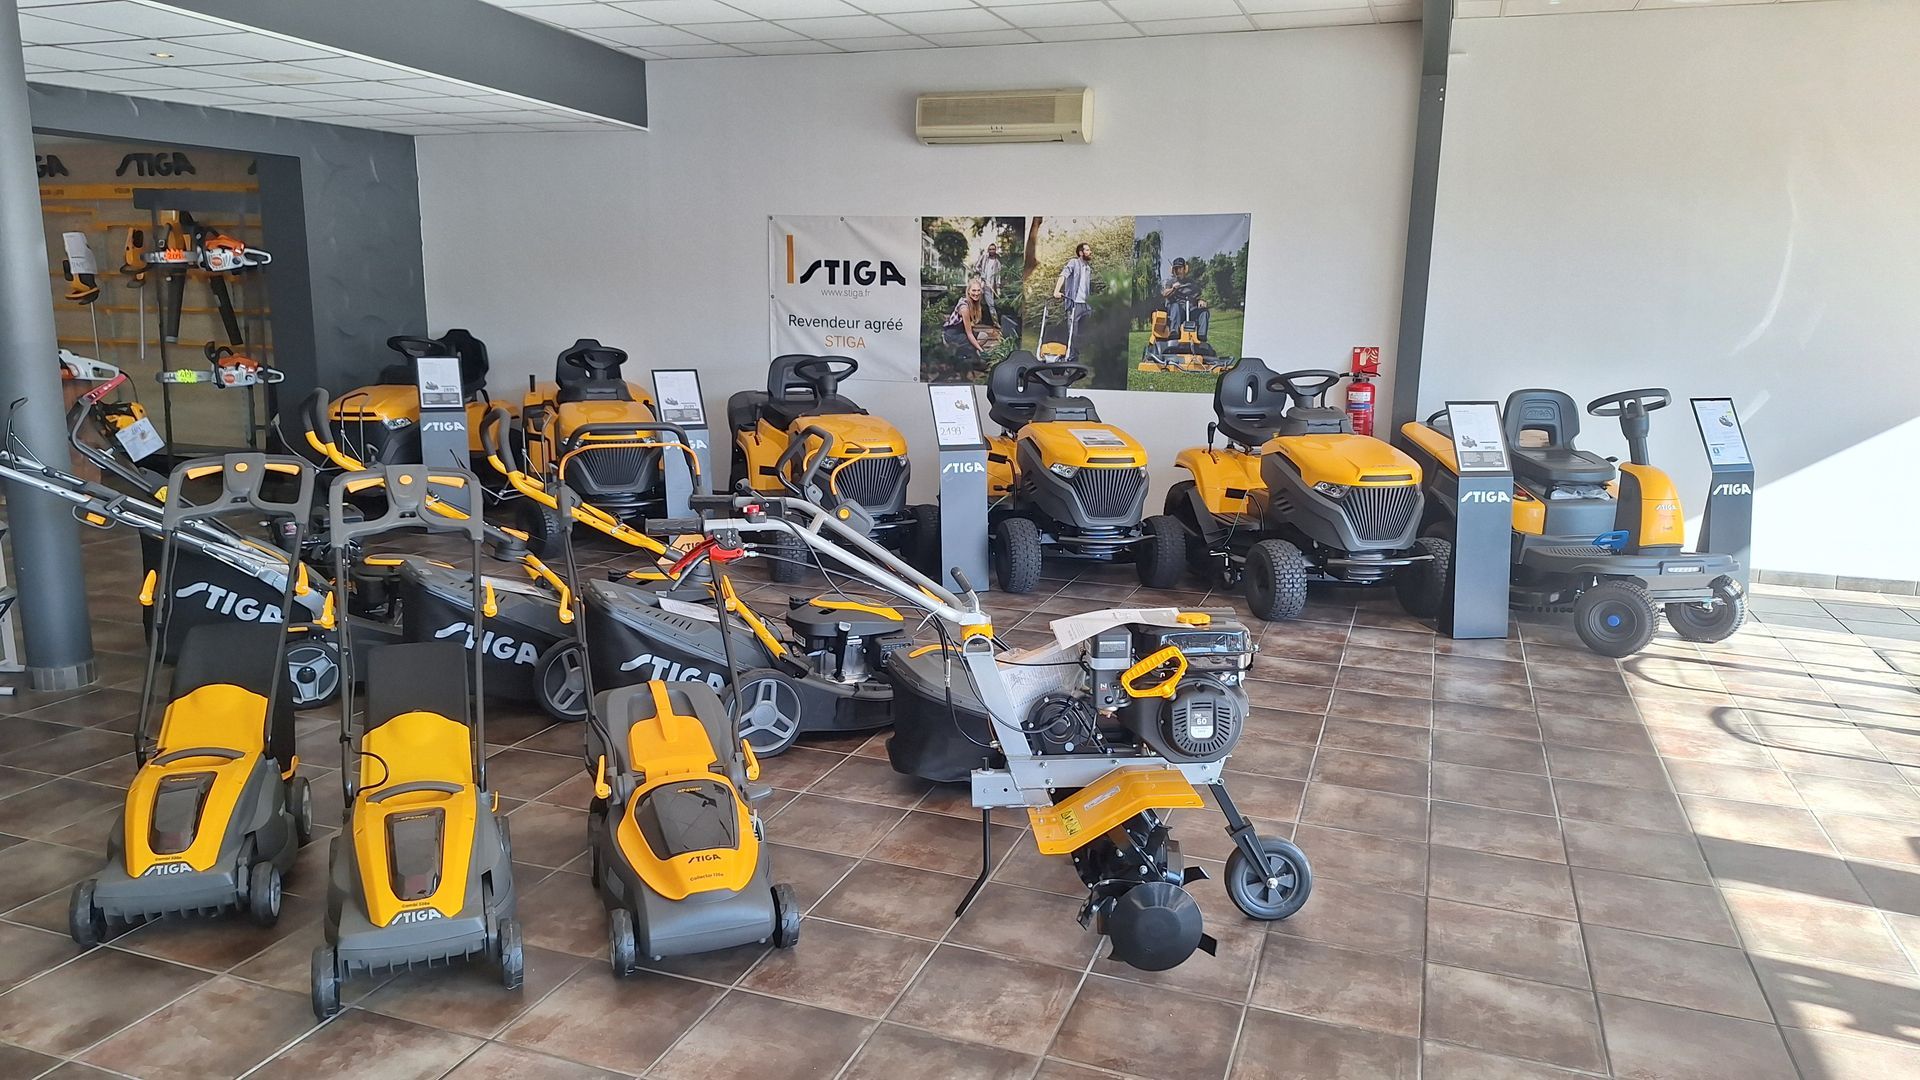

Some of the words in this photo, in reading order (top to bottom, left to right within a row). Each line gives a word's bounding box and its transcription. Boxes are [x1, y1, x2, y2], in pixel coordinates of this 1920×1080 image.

[116, 152, 196, 176] STIGA
[800, 259, 906, 286] STIGA
[821, 288, 871, 299] www.stiga.fr
[788, 314, 860, 329] Revendeur
[864, 317, 904, 333] agréé
[824, 335, 866, 348] STIGA
[422, 421, 465, 432] STIGA
[942, 462, 985, 474] STIGA
[1713, 483, 1752, 496] STIGA
[1461, 490, 1511, 503] STIGA
[176, 582, 284, 624] STIGA
[688, 854, 722, 864] STIGA
[144, 862, 193, 877] STIGA
[391, 908, 442, 926] STIGA
